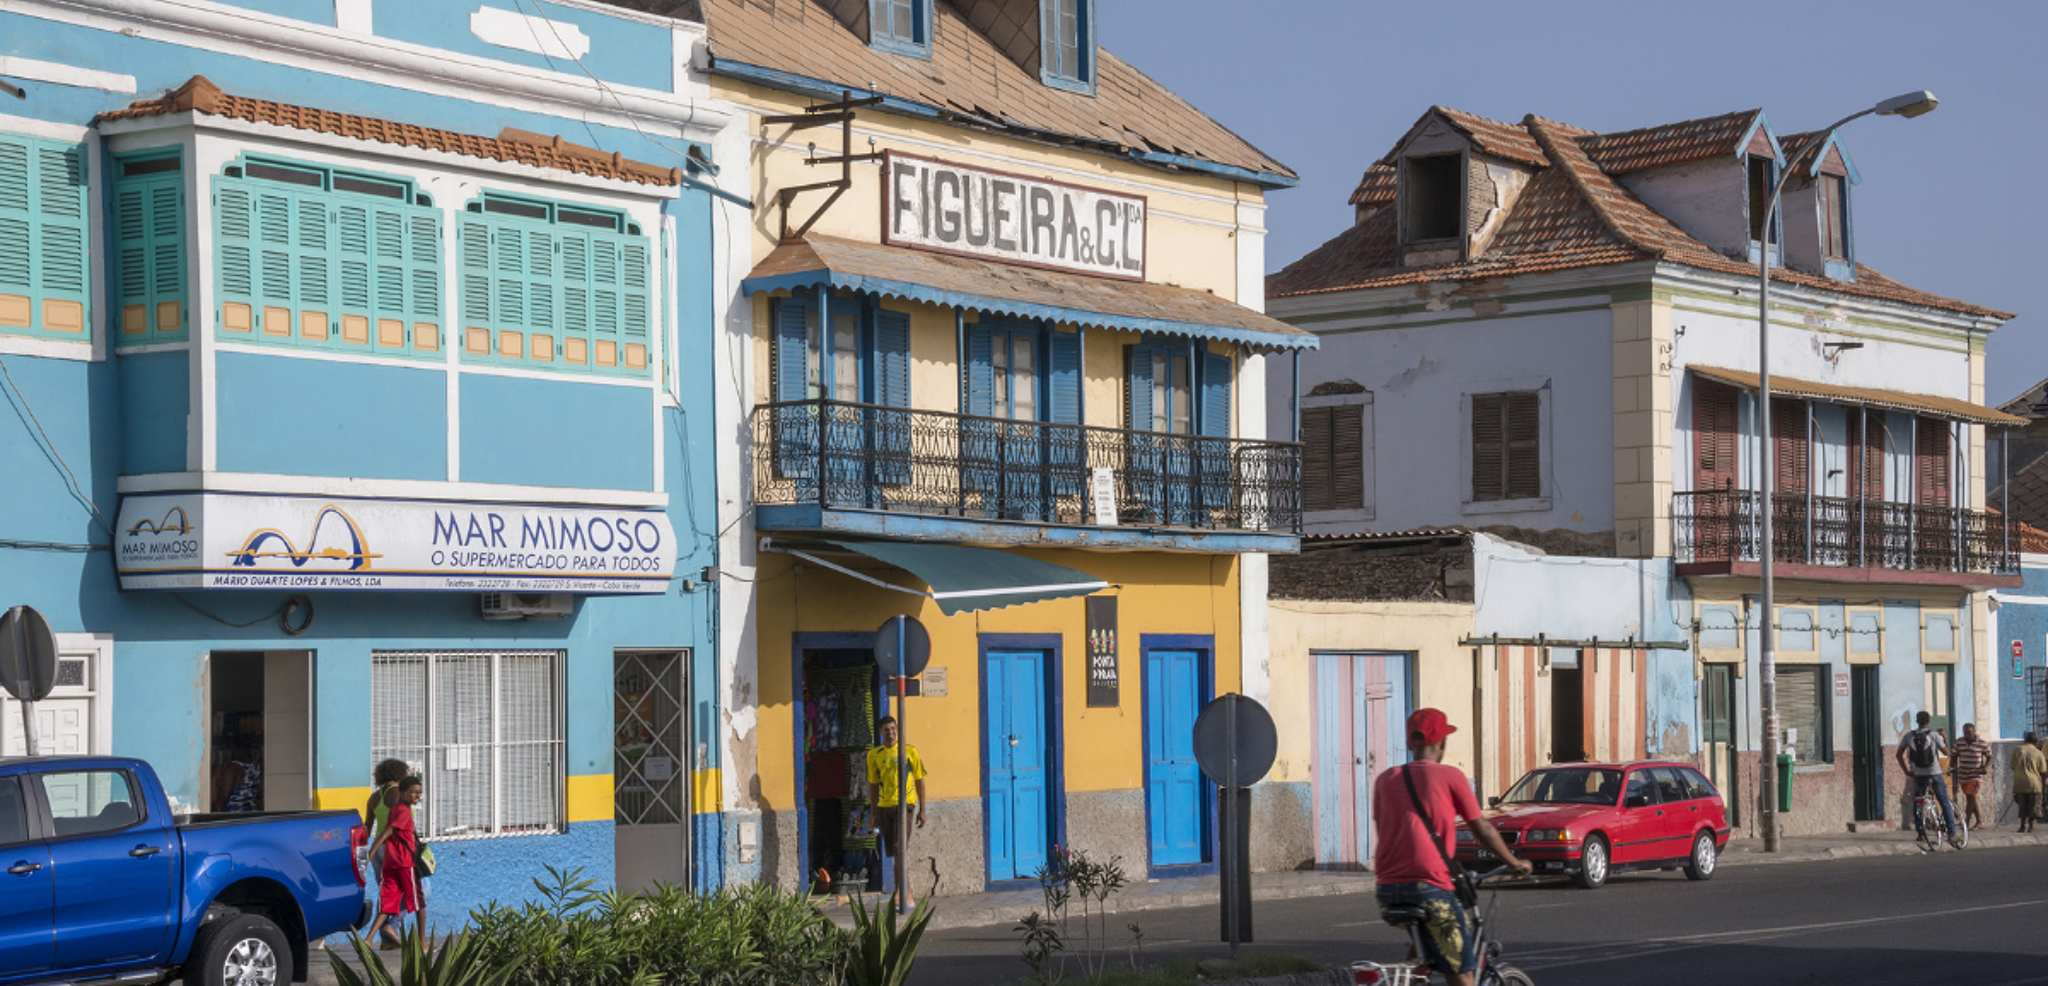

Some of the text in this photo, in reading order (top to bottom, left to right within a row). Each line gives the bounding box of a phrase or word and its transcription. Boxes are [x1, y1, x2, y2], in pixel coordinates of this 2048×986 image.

[893, 161, 1080, 262] FIGUEIRA
[1079, 226, 1096, 265] &
[431, 510, 661, 553] MAR MIMOSO
[122, 540, 198, 554] MAR MIMOSO
[431, 550, 661, 572] O SUPERMERCADO PARA TODOS
[213, 575, 248, 586] MÁRIO
[250, 576, 288, 586] DUARTE
[290, 577, 318, 586] LOPES
[320, 577, 327, 586] &
[364, 577, 382, 586] LDA
